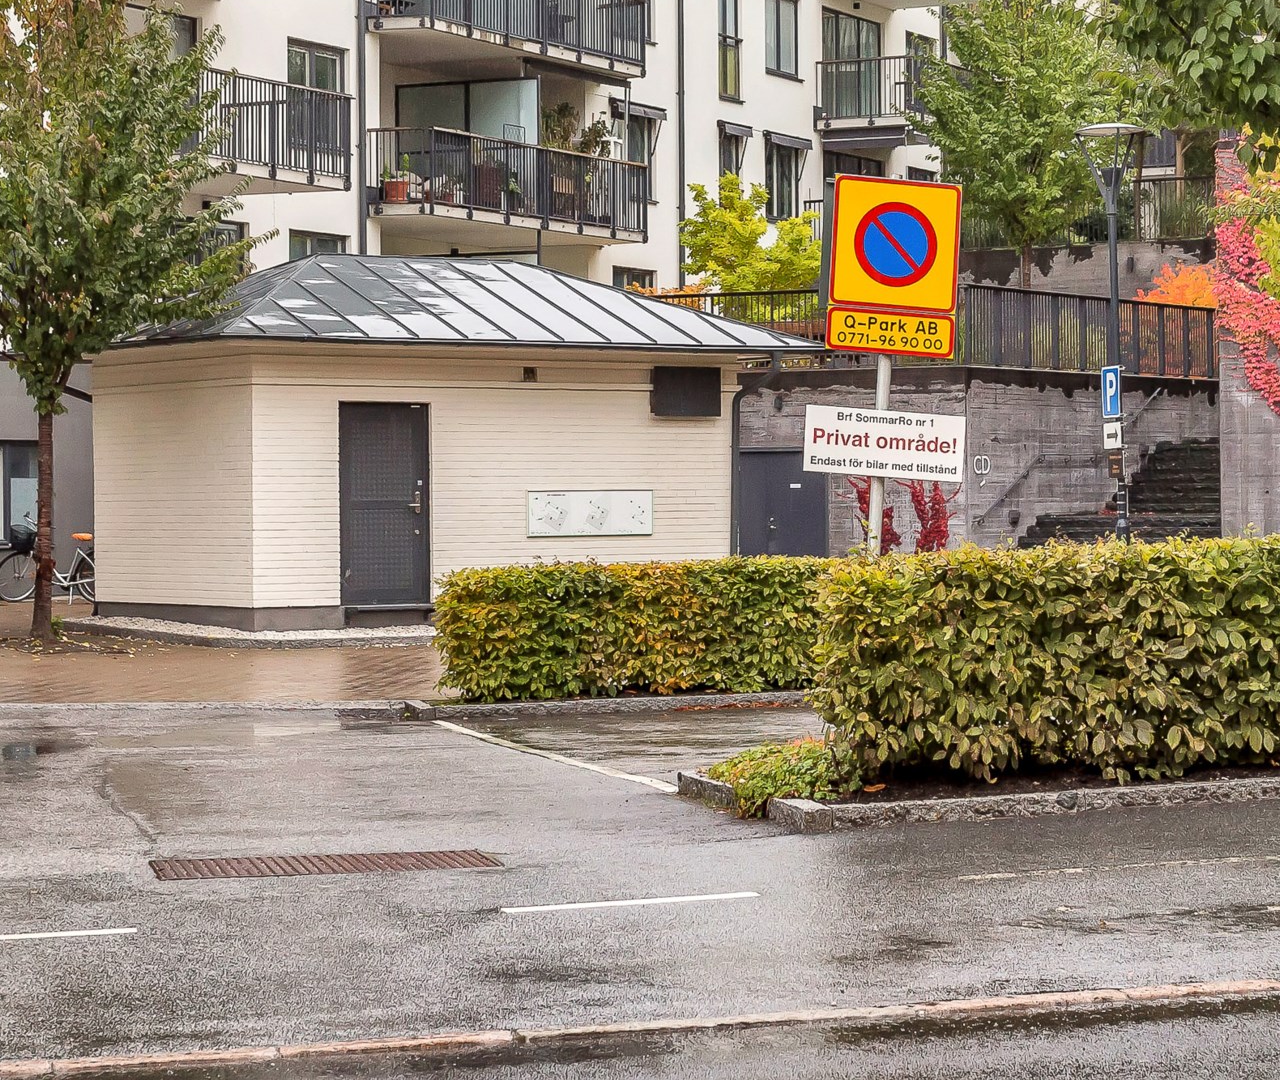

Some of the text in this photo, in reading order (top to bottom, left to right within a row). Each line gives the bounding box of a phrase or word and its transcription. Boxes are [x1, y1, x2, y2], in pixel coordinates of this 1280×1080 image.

[844, 314, 938, 336] Q-Park AB
[837, 331, 943, 350] 0771-96 90 00
[1105, 372, 1116, 412] P
[837, 411, 934, 427] Brf SommarRo nr 1
[812, 427, 957, 454] Privat område!
[810, 455, 957, 475] Endast för bilar med tillstånd
